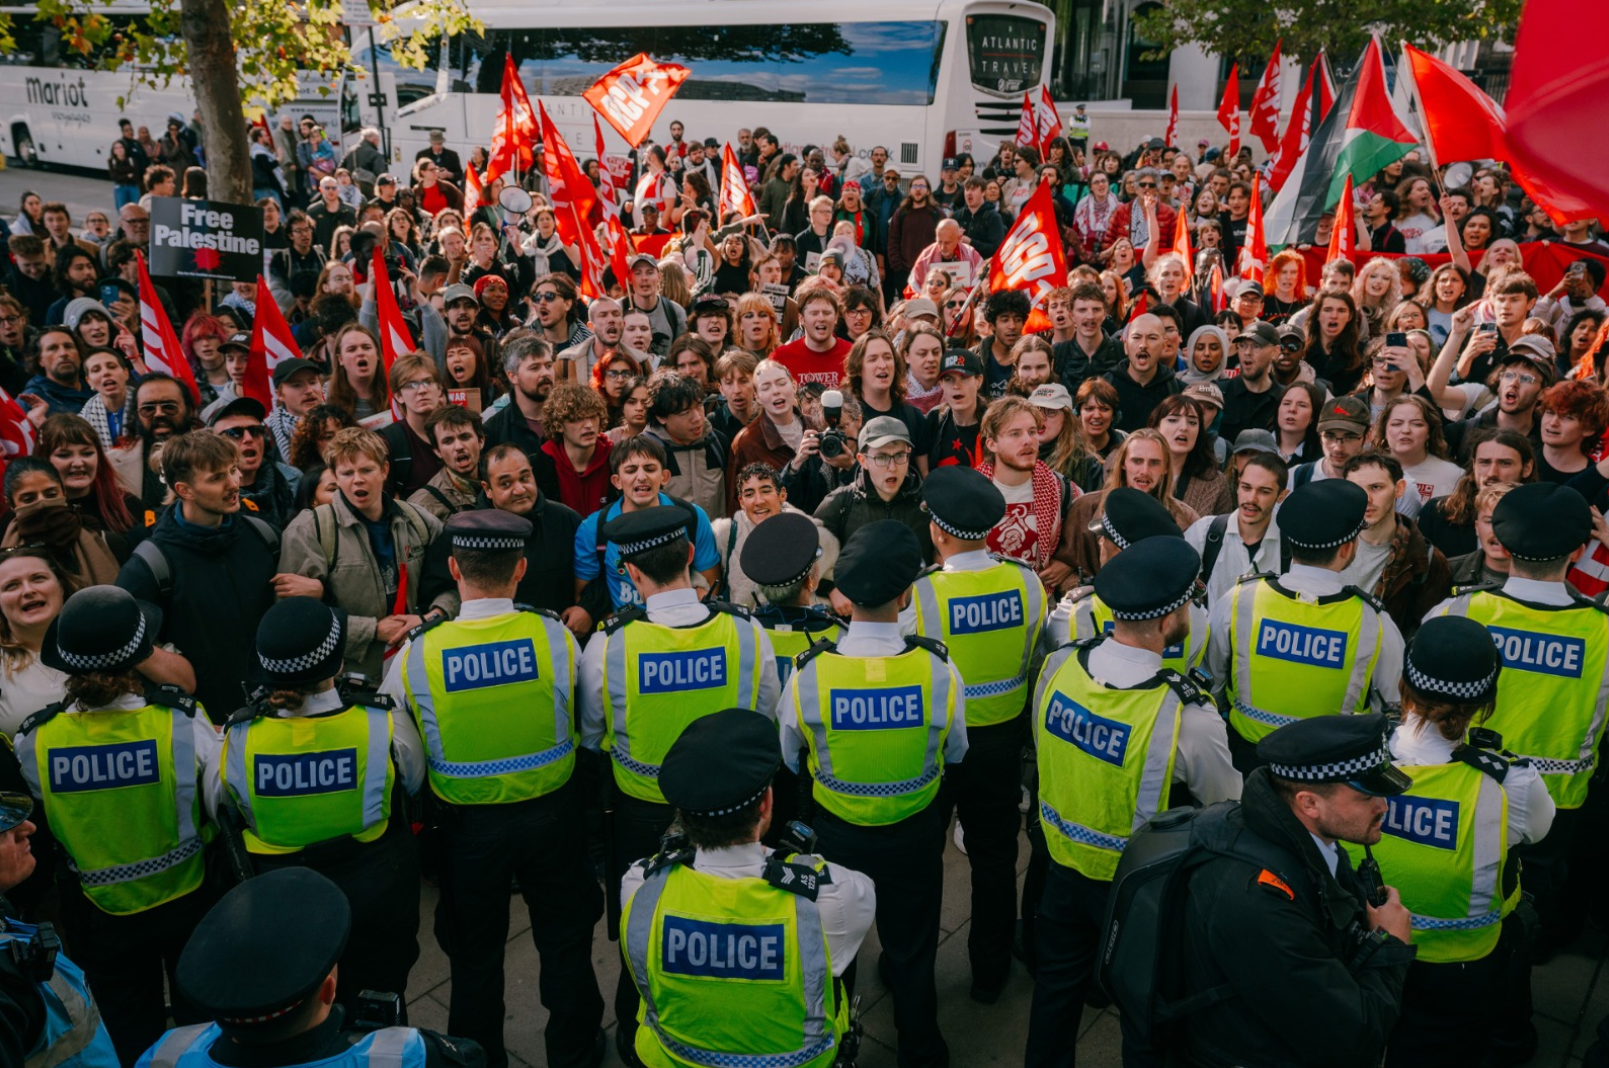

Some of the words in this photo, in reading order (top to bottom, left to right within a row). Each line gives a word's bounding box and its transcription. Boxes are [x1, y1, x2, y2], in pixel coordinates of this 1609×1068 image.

[982, 36, 1037, 51] ATLANTIC
[982, 61, 1036, 74] TRAVEL
[26, 72, 89, 107] mariot
[600, 73, 651, 132] RCP
[181, 204, 234, 229] Free
[155, 224, 260, 255] Palestine
[1000, 211, 1056, 287] RCP
[797, 371, 839, 384] TOWER
[953, 596, 1021, 629] POLICE
[1261, 625, 1342, 663] POLICE
[447, 646, 533, 684] POLICE
[643, 655, 723, 687] POLICE
[835, 694, 919, 724] POLICE
[1047, 698, 1124, 759] POLICE
[54, 749, 153, 784] POLICE
[258, 757, 352, 790] POLICE
[1383, 800, 1453, 841] LICE
[800, 874, 809, 885] AS
[668, 927, 778, 970] POLICE
